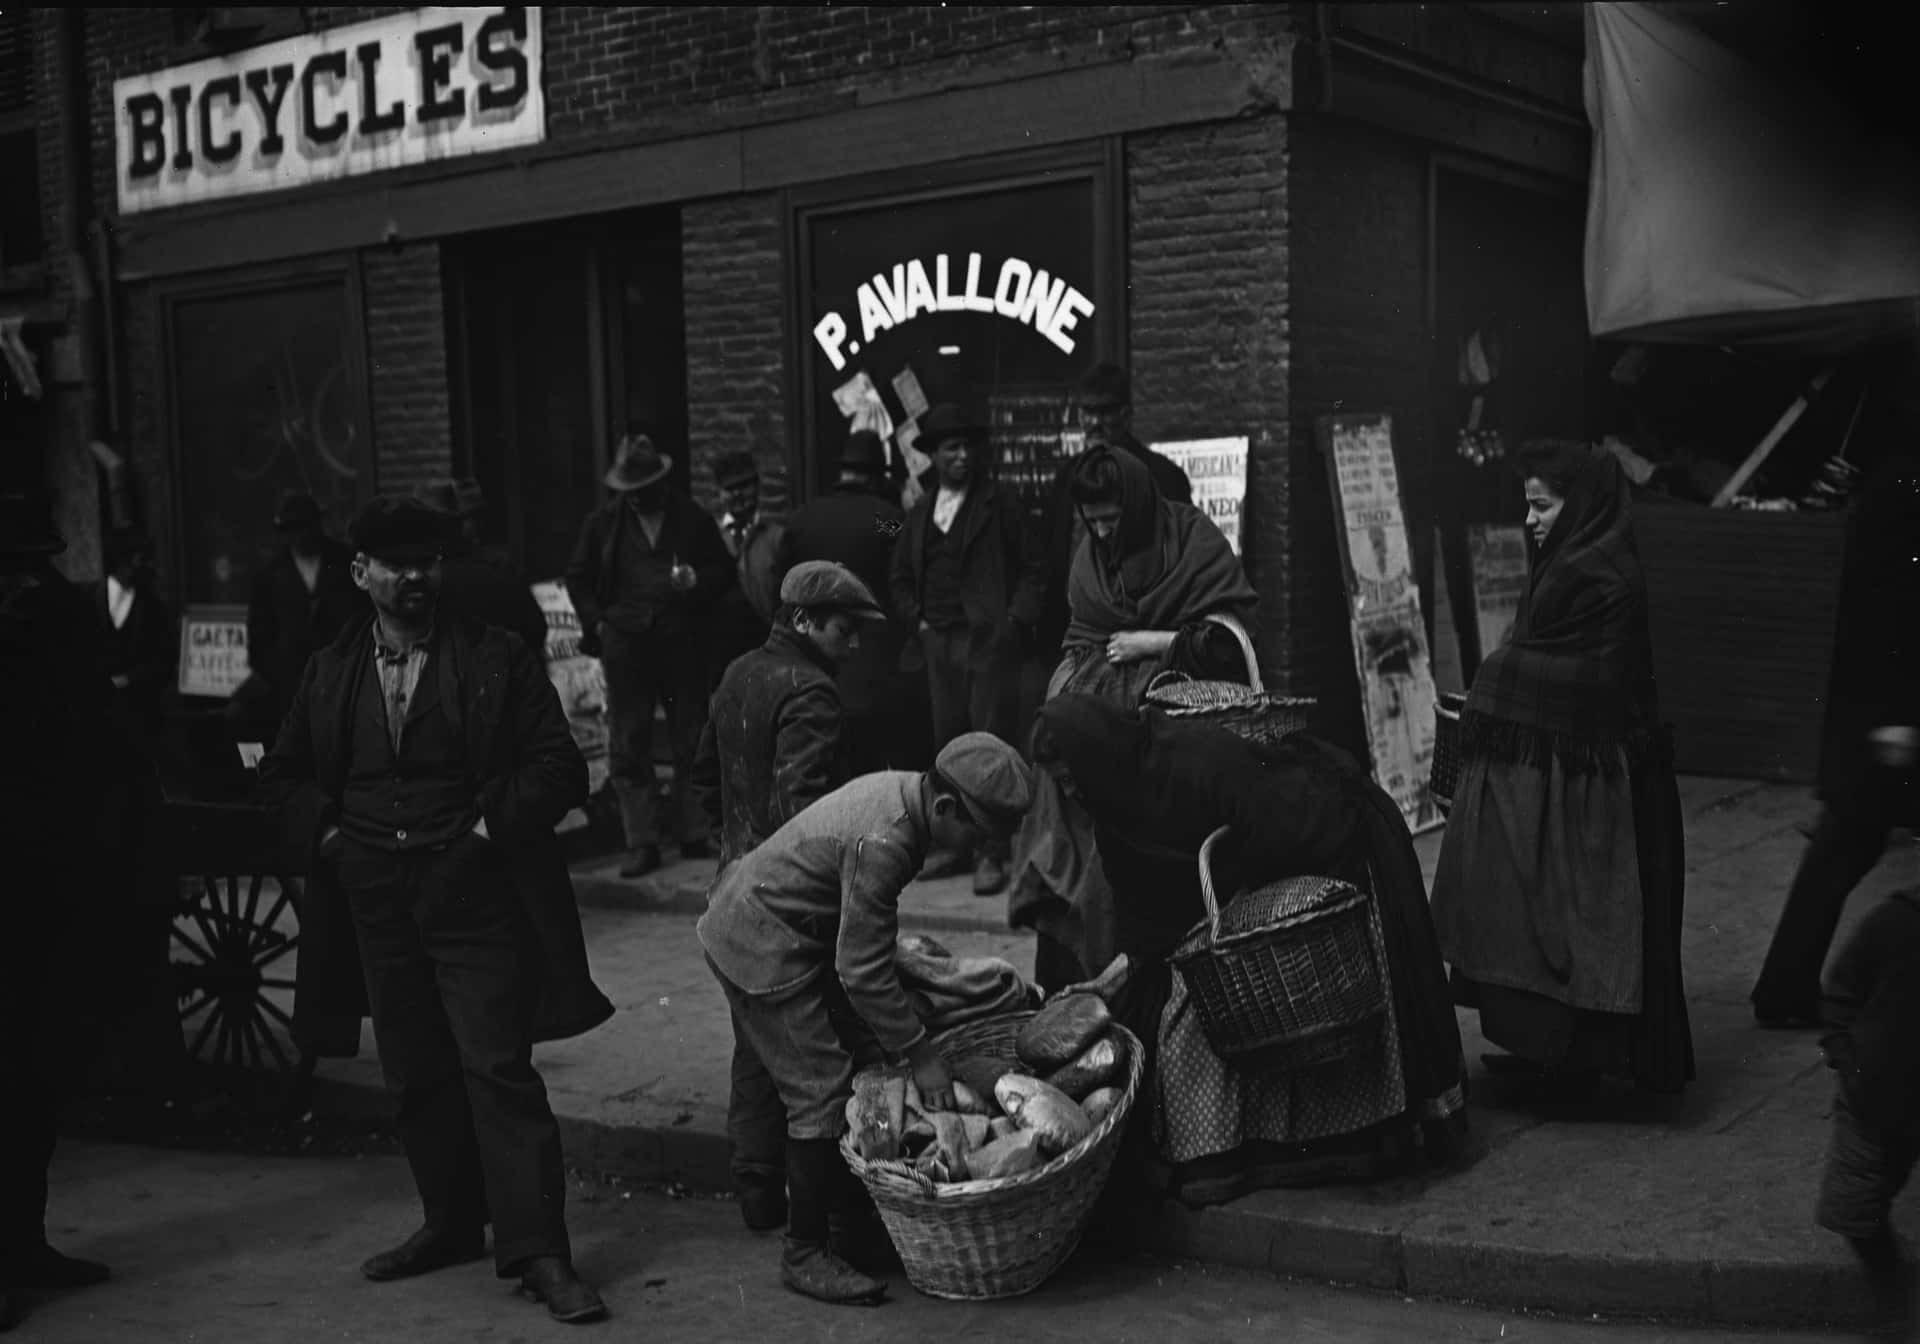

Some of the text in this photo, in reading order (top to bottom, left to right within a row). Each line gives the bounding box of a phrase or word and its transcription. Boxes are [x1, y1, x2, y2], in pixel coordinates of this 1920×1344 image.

[126, 8, 529, 178] BICYCLES
[813, 252, 1095, 371] P. AVALLONE
